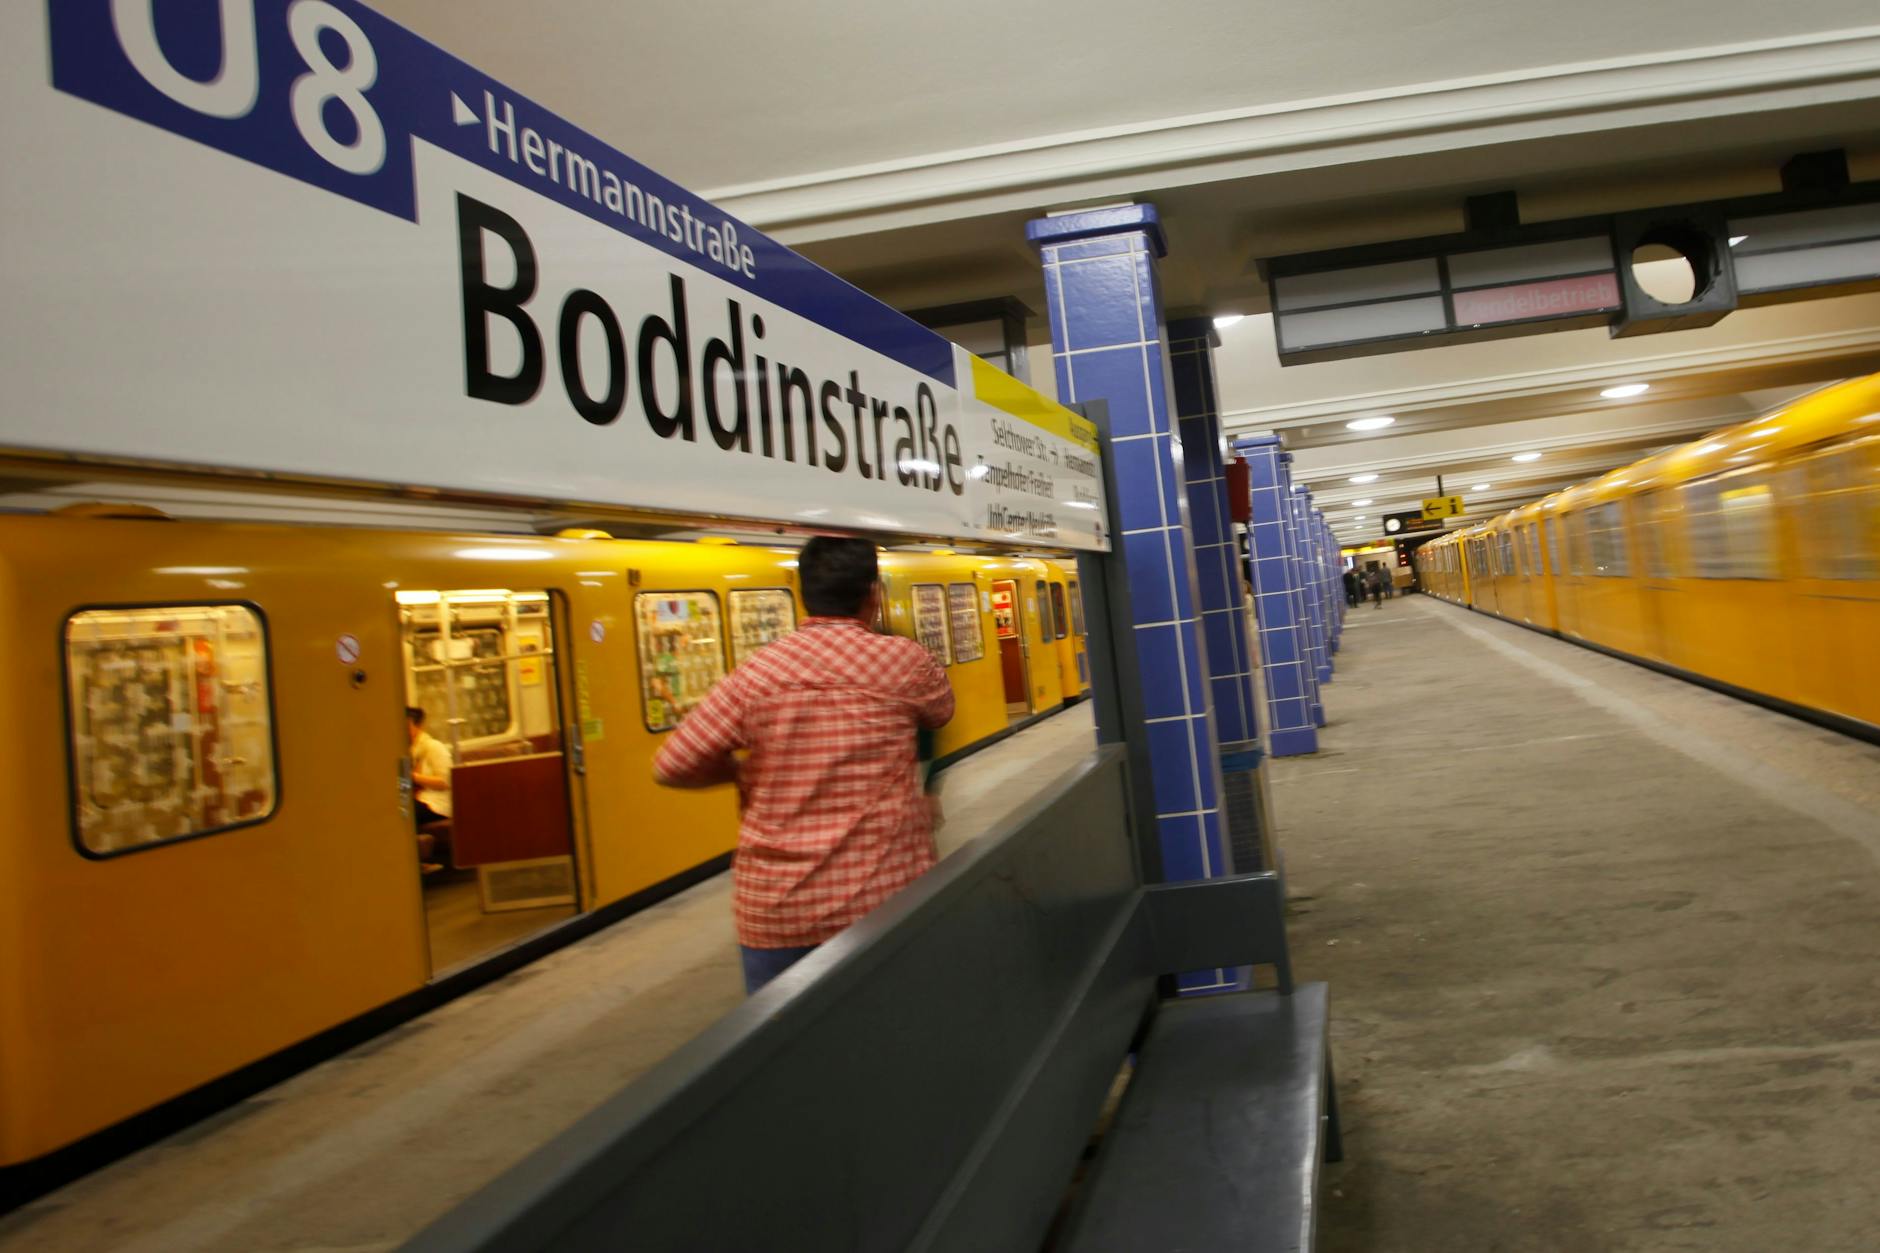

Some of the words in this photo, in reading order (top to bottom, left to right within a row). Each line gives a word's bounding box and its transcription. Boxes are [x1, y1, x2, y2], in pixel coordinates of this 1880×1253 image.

[111, 0, 387, 176] U8
[484, 90, 756, 280] Hermannstraße
[455, 190, 965, 496] Boddinstraße
[1463, 280, 1612, 319] endelbetrieb
